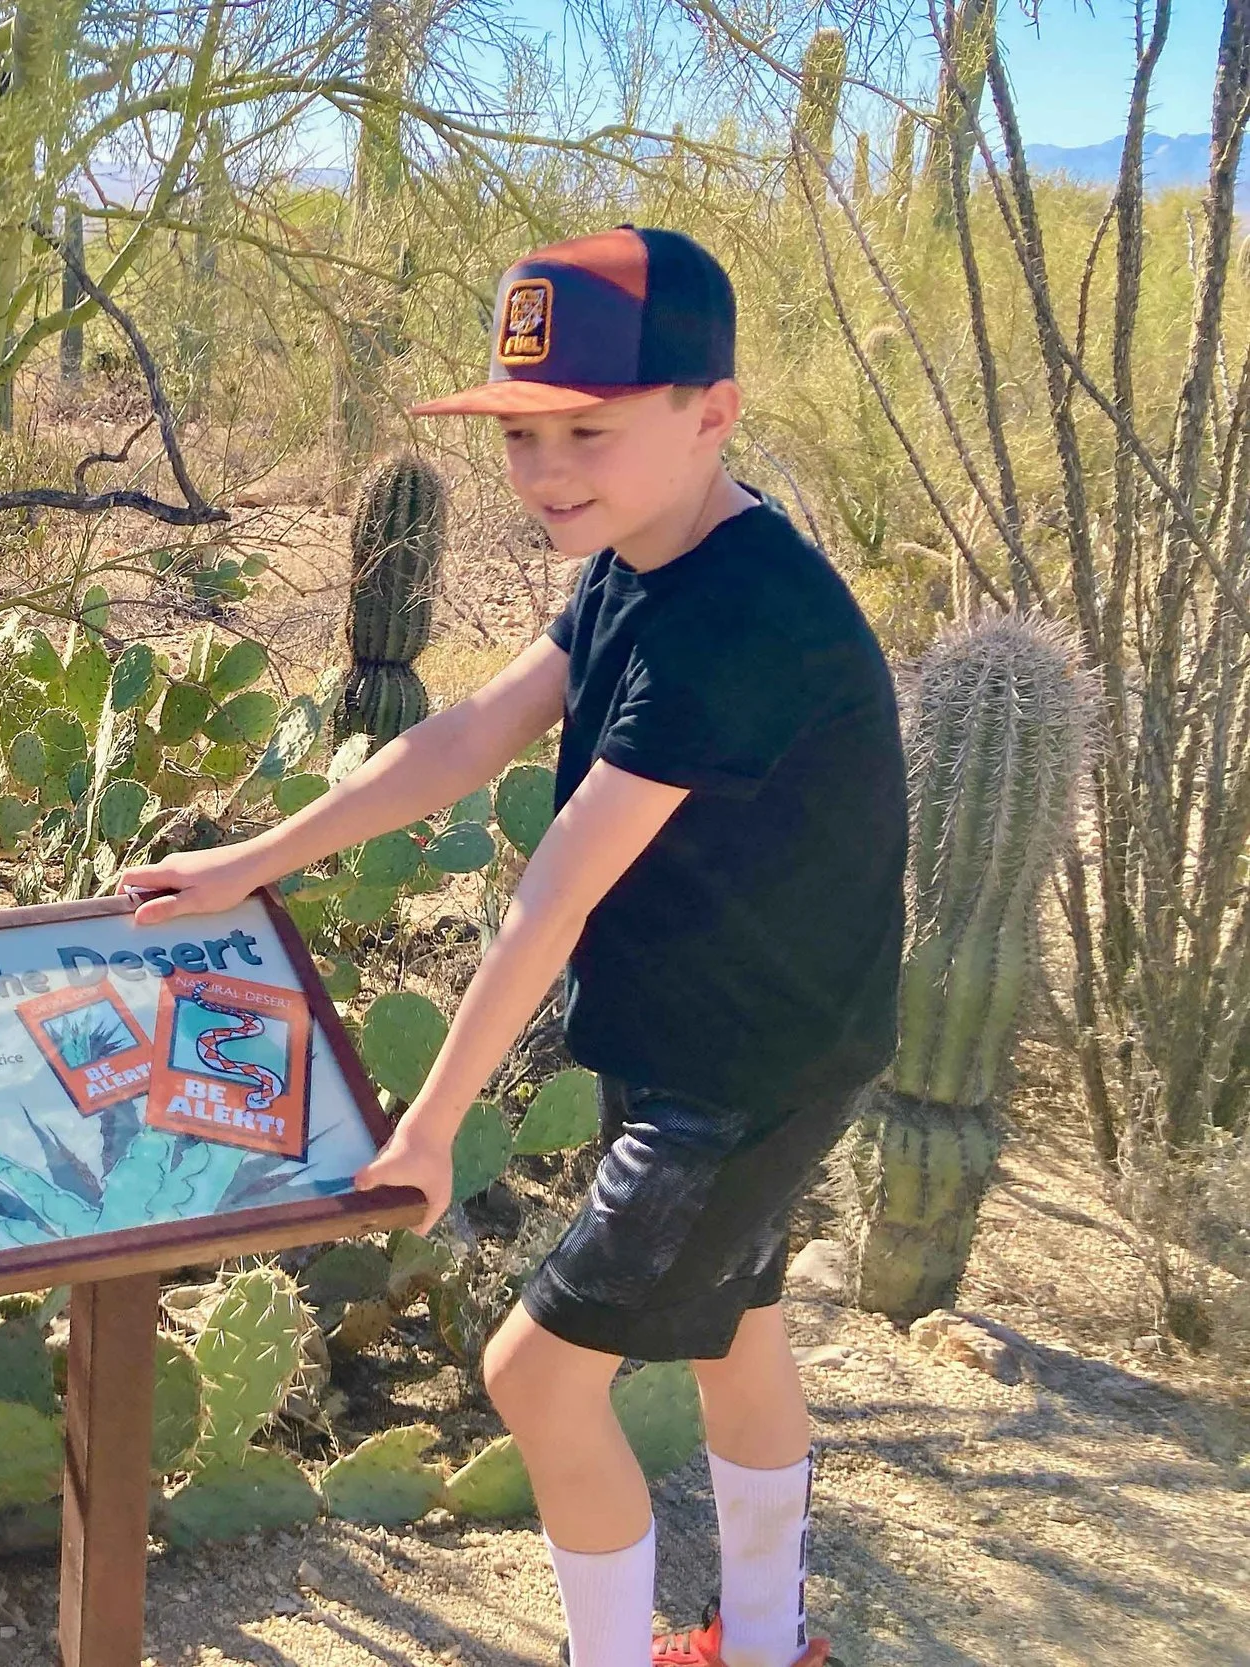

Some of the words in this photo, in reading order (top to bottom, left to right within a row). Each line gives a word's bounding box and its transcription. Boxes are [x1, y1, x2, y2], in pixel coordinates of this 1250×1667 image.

[56, 928, 263, 987] Desert
[244, 990, 292, 1010] DESERT
[84, 1062, 115, 1081] BE
[184, 1078, 226, 1104] BE
[166, 1095, 285, 1136] ALERT!
